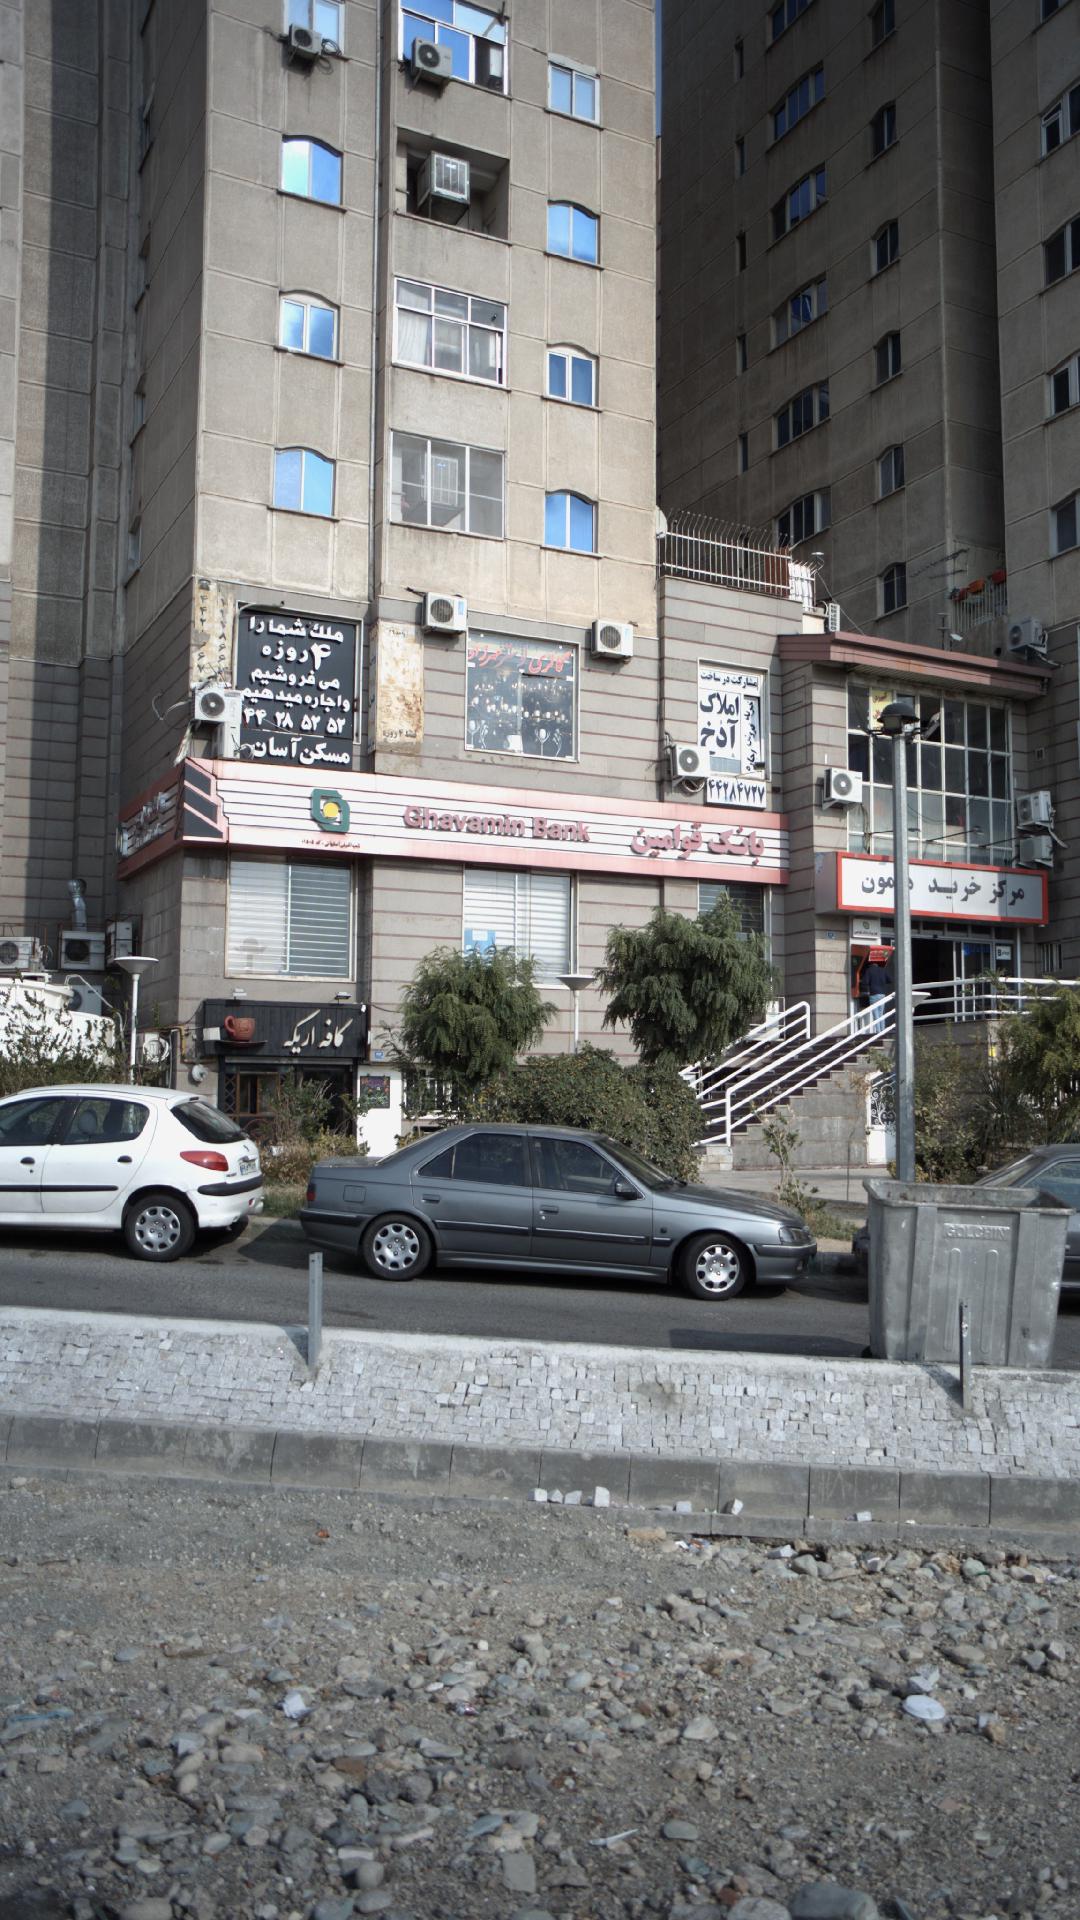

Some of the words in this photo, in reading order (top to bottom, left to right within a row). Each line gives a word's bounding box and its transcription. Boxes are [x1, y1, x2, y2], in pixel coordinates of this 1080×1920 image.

[249, 615, 266, 634] را
[268, 618, 307, 638] شما
[262, 640, 309, 663] روزه
[311, 643, 331, 670] ۴
[251, 665, 316, 687] فروشیم
[319, 678, 340, 690] می
[700, 672, 720, 682] ساخت
[722, 676, 730, 685] در
[700, 692, 739, 716] املاک
[253, 737, 302, 758] آسان
[300, 743, 350, 765] مسکن
[403, 805, 526, 837] Ghavamin
[532, 816, 590, 843] Bank
[630, 822, 703, 859] قوامین
[708, 825, 764, 866] بانک
[928, 875, 981, 902] خرید
[989, 880, 1025, 906] مرکز
[283, 1009, 321, 1054] اریکه
[318, 1018, 354, 1048] کافه
